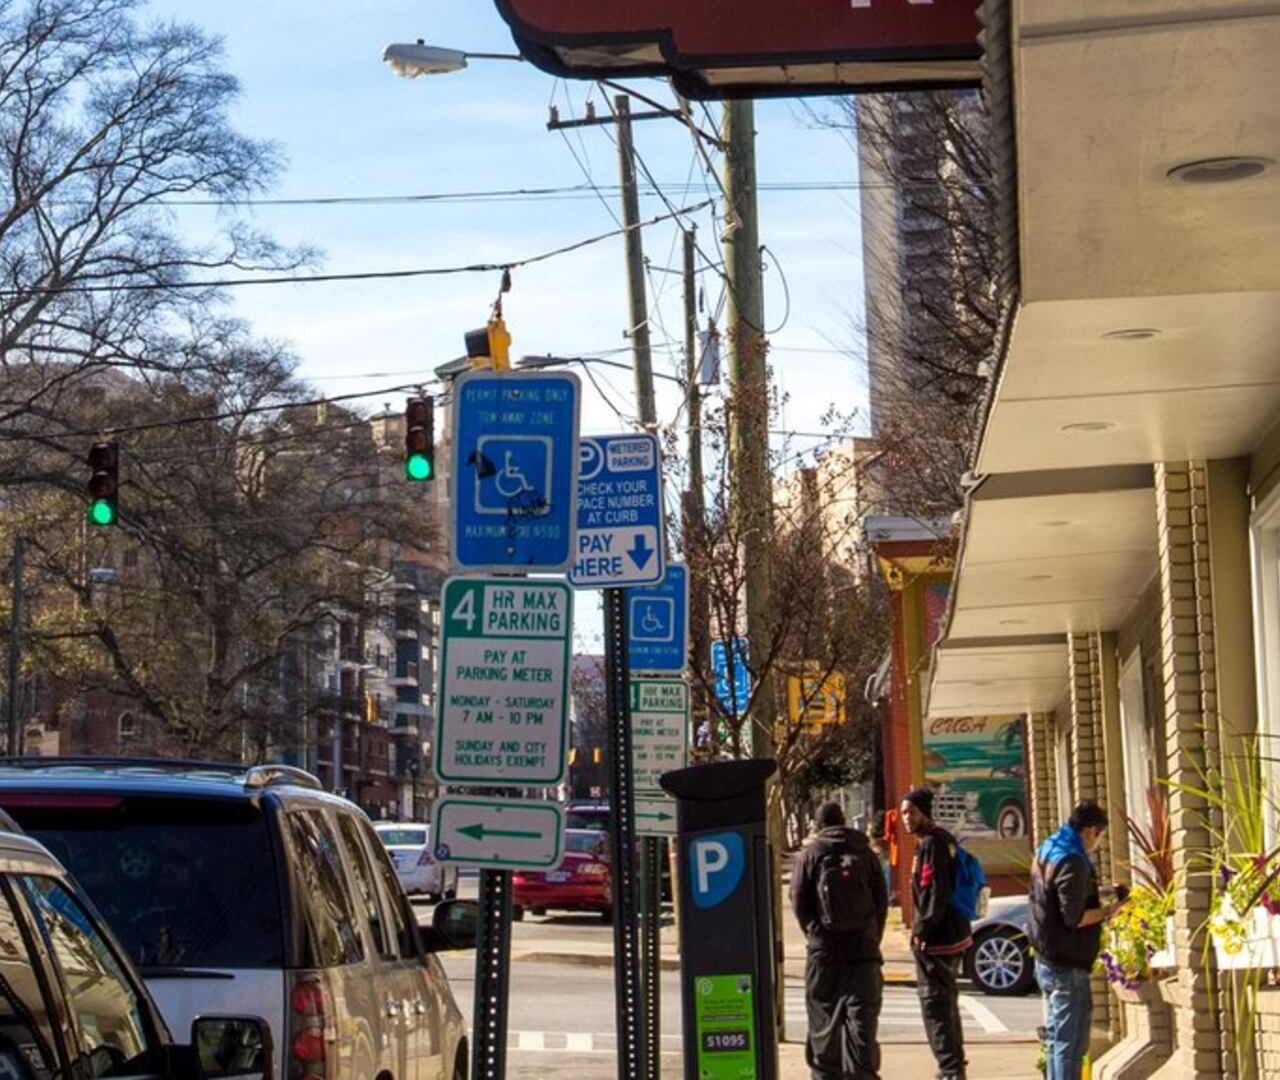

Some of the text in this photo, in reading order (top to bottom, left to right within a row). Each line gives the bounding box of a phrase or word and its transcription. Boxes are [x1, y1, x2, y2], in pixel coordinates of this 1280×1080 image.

[608, 441, 650, 453] METERED
[612, 457, 649, 467] PARKING
[617, 480, 647, 493] YOUR
[578, 494, 654, 509] PACE NUMBER
[587, 509, 638, 524] AT CURB
[580, 534, 613, 553] PAY
[573, 556, 623, 577] HERE
[451, 588, 557, 631] 4 HR MAX
[488, 611, 561, 632] PARKING
[483, 650, 527, 664] PAY AT
[456, 666, 553, 682] PARKING METER
[661, 686, 681, 696] MAX
[450, 695, 491, 707] MONDAY
[504, 696, 555, 709] SATURDAY
[642, 697, 683, 709] PARKING
[463, 709, 470, 723] 7
[475, 710, 494, 724] AM
[509, 711, 522, 725] 10
[526, 712, 544, 725] PM
[930, 716, 986, 735] CUBA
[455, 740, 547, 754] SUNDAY AND CITY
[454, 754, 546, 768] HOLIDAYS EXEMPT
[696, 841, 728, 893] P
